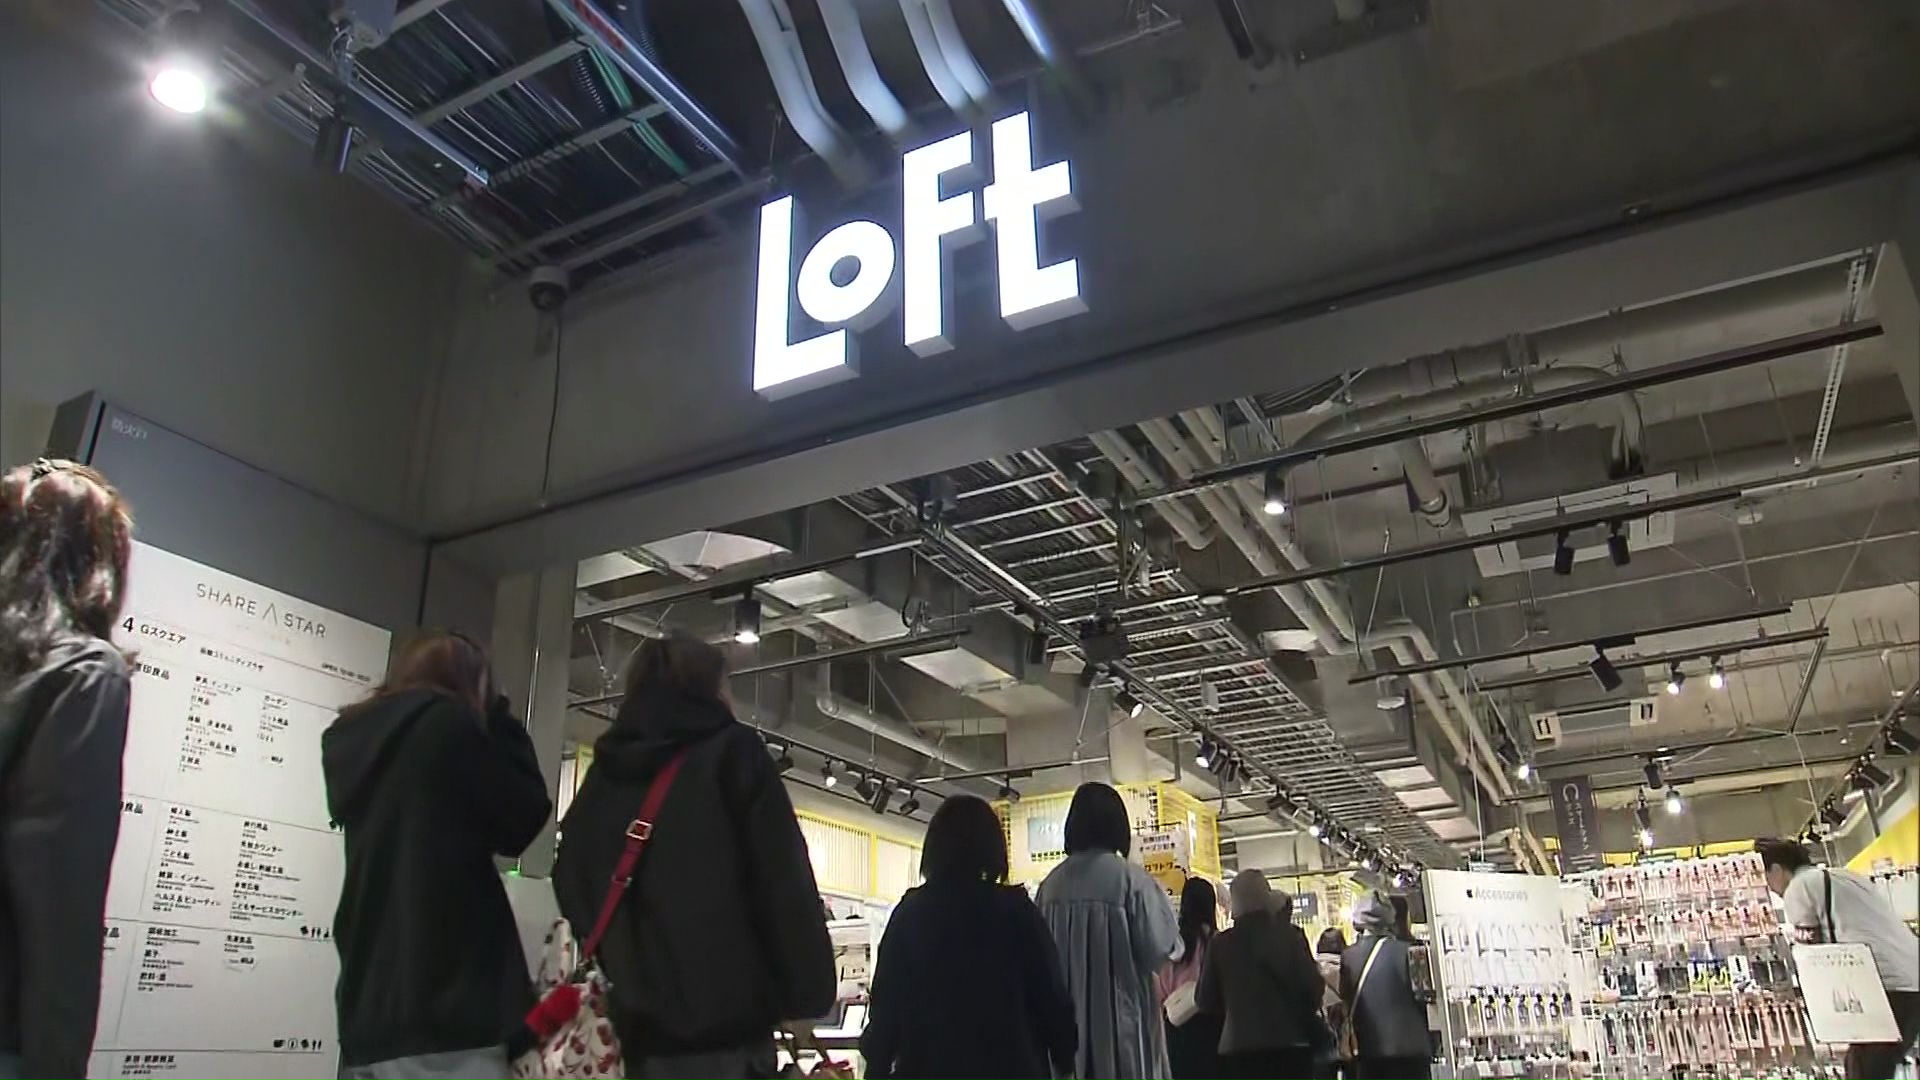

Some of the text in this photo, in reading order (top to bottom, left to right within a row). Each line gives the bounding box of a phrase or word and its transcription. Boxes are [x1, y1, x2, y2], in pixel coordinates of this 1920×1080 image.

[196, 582, 257, 616] SHARE
[284, 613, 327, 638] STAR
[122, 617, 186, 644] 4 Gスクエア
[1475, 885, 1528, 902] Accessories
